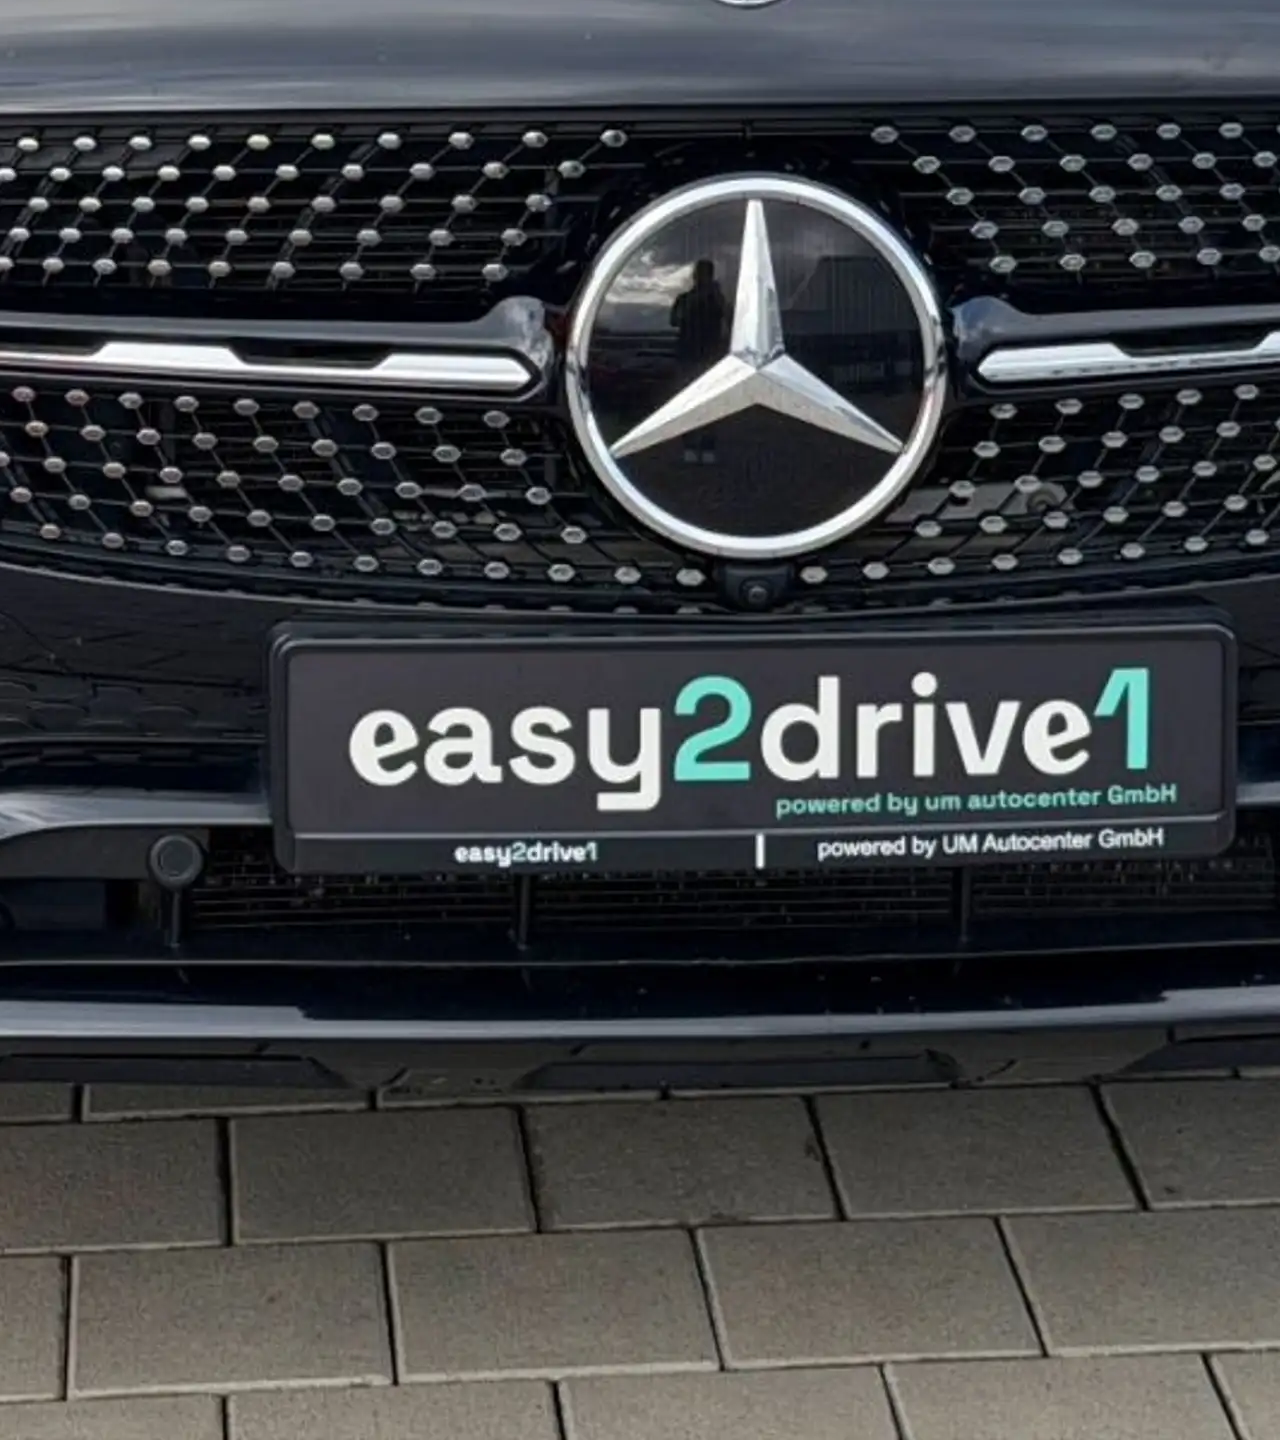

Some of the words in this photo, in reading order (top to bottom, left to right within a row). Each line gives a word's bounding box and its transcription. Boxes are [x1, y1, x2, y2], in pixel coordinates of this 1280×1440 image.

[349, 667, 1150, 811] easy2drive1
[776, 793, 881, 820] powered
[887, 791, 918, 816] by
[924, 795, 961, 810] um
[967, 788, 1102, 810] autocenter
[1107, 783, 1178, 805] GmbH
[455, 841, 598, 868] easy2drive1
[817, 835, 907, 862] powered
[911, 835, 937, 860] by
[942, 832, 978, 854] UM
[982, 830, 1094, 853] Autocenter
[1098, 827, 1165, 850] GmbH
